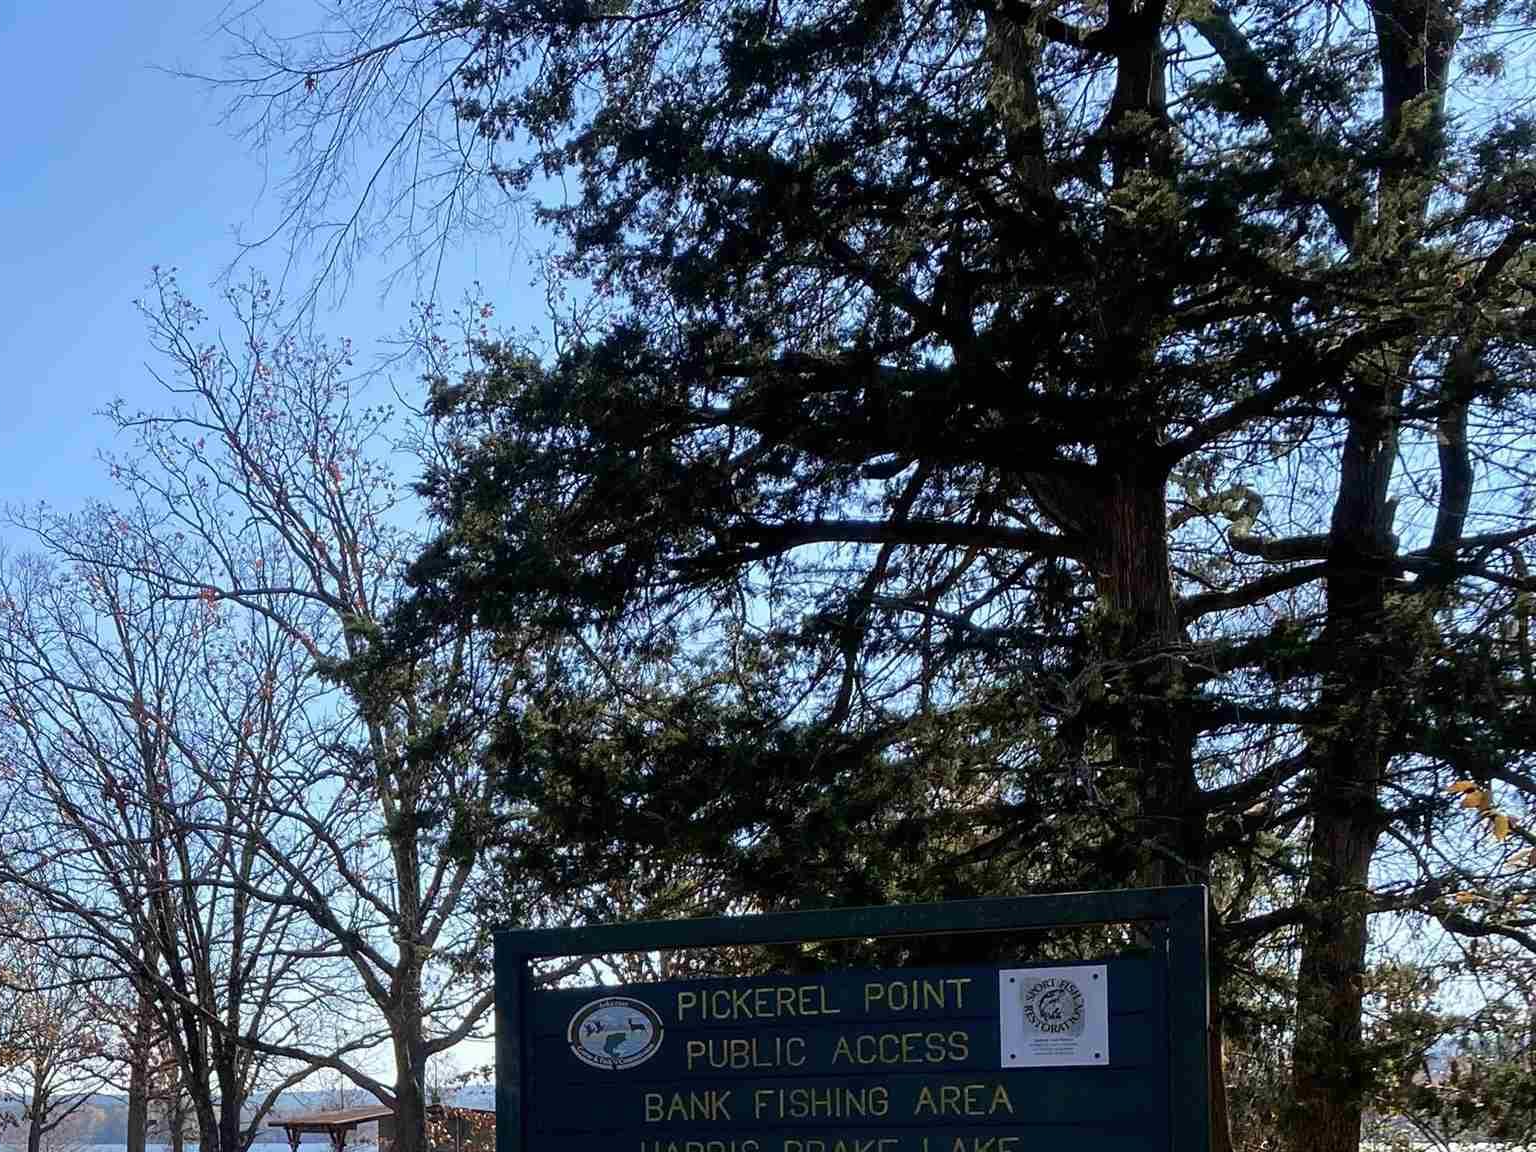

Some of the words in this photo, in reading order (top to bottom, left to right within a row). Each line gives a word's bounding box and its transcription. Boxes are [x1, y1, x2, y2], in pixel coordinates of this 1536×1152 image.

[677, 985, 840, 1019] PICKEREL
[864, 978, 971, 1012] POINT
[686, 1037, 805, 1069] PUBLIC
[832, 1033, 968, 1065] ACCESS
[645, 1092, 731, 1121] BANK
[755, 1088, 888, 1118] FISHING
[914, 1085, 1014, 1115] AREA
